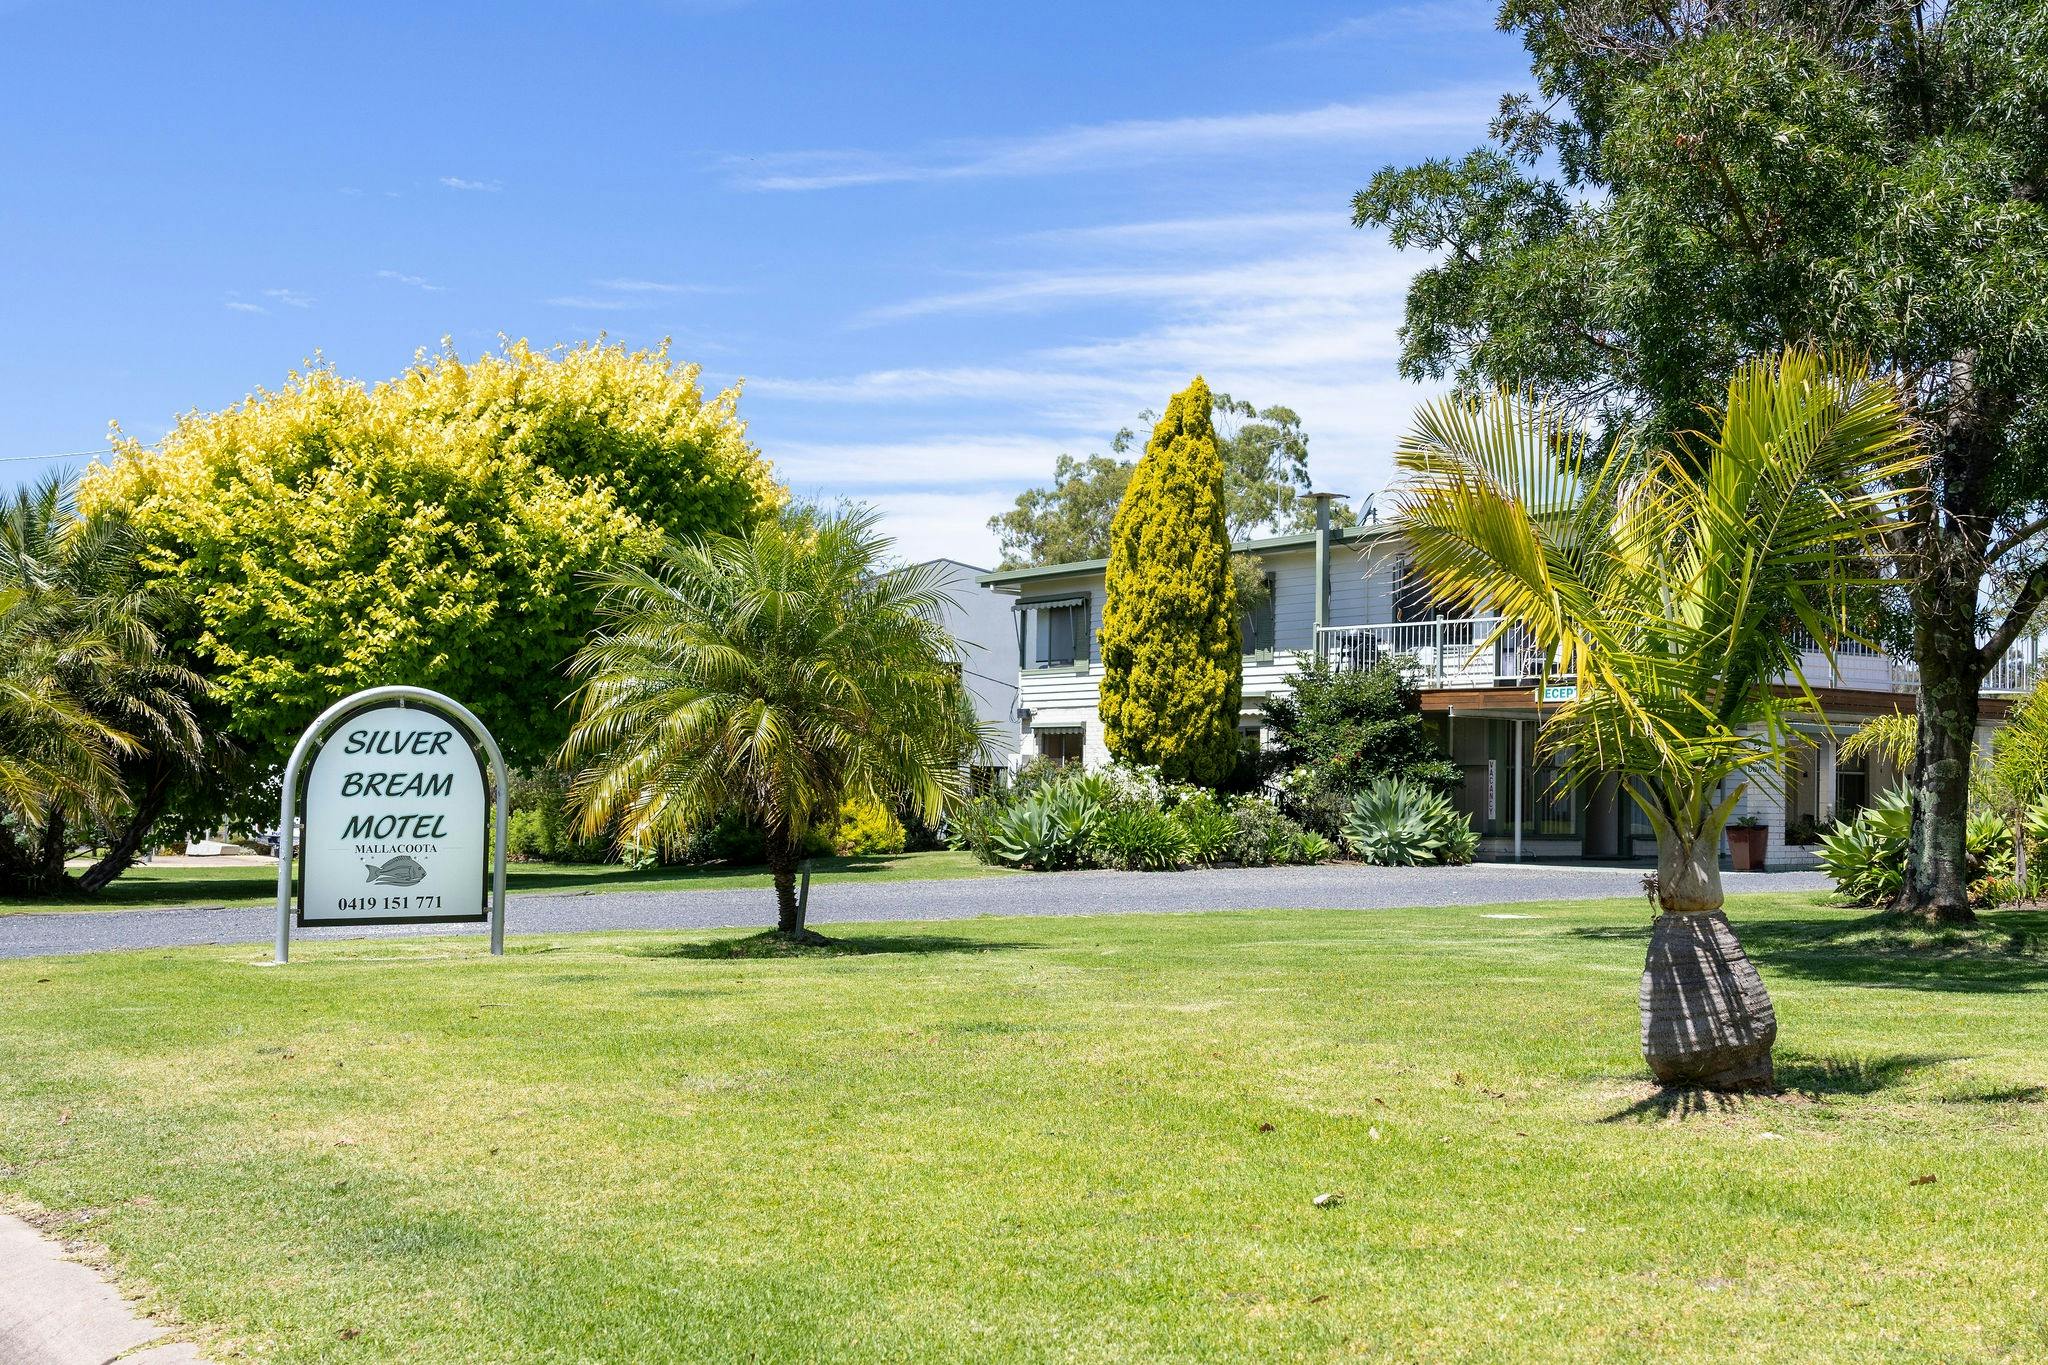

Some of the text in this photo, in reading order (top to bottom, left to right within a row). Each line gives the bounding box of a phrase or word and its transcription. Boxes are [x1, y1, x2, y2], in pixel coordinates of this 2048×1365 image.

[1544, 687, 1578, 699] ECEP
[344, 730, 453, 755] SILVER
[341, 772, 454, 797] BREAM
[341, 814, 448, 840] MOTEL
[355, 844, 438, 854] MALLACOOTA
[338, 895, 442, 911] 0419 151 771
